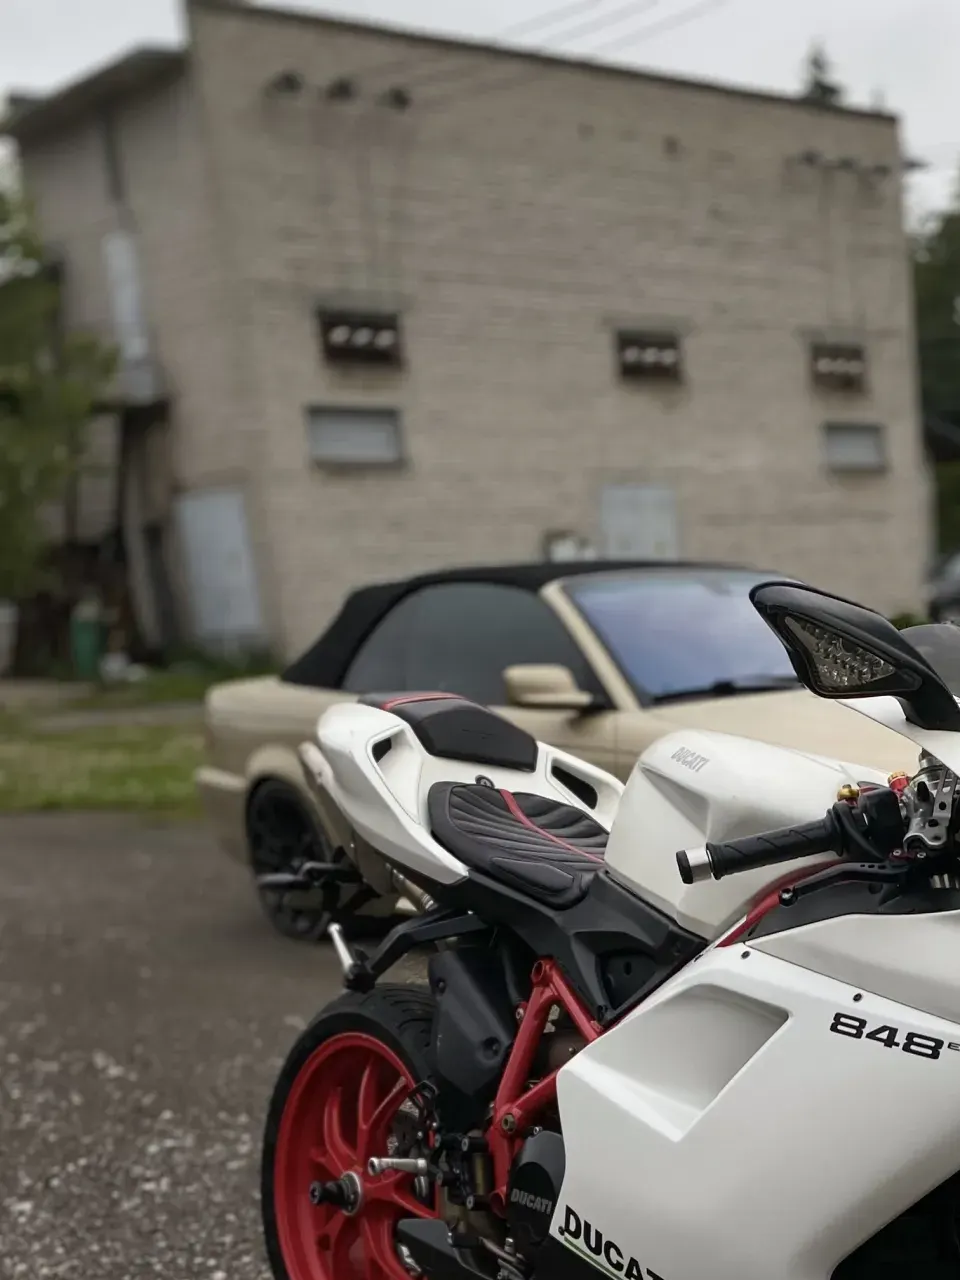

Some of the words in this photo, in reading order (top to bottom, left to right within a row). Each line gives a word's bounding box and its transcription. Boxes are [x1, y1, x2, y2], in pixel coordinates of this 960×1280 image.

[671, 746, 710, 772] DUCATI
[829, 1012, 945, 1060] 848
[510, 1187, 553, 1215] DUCATI
